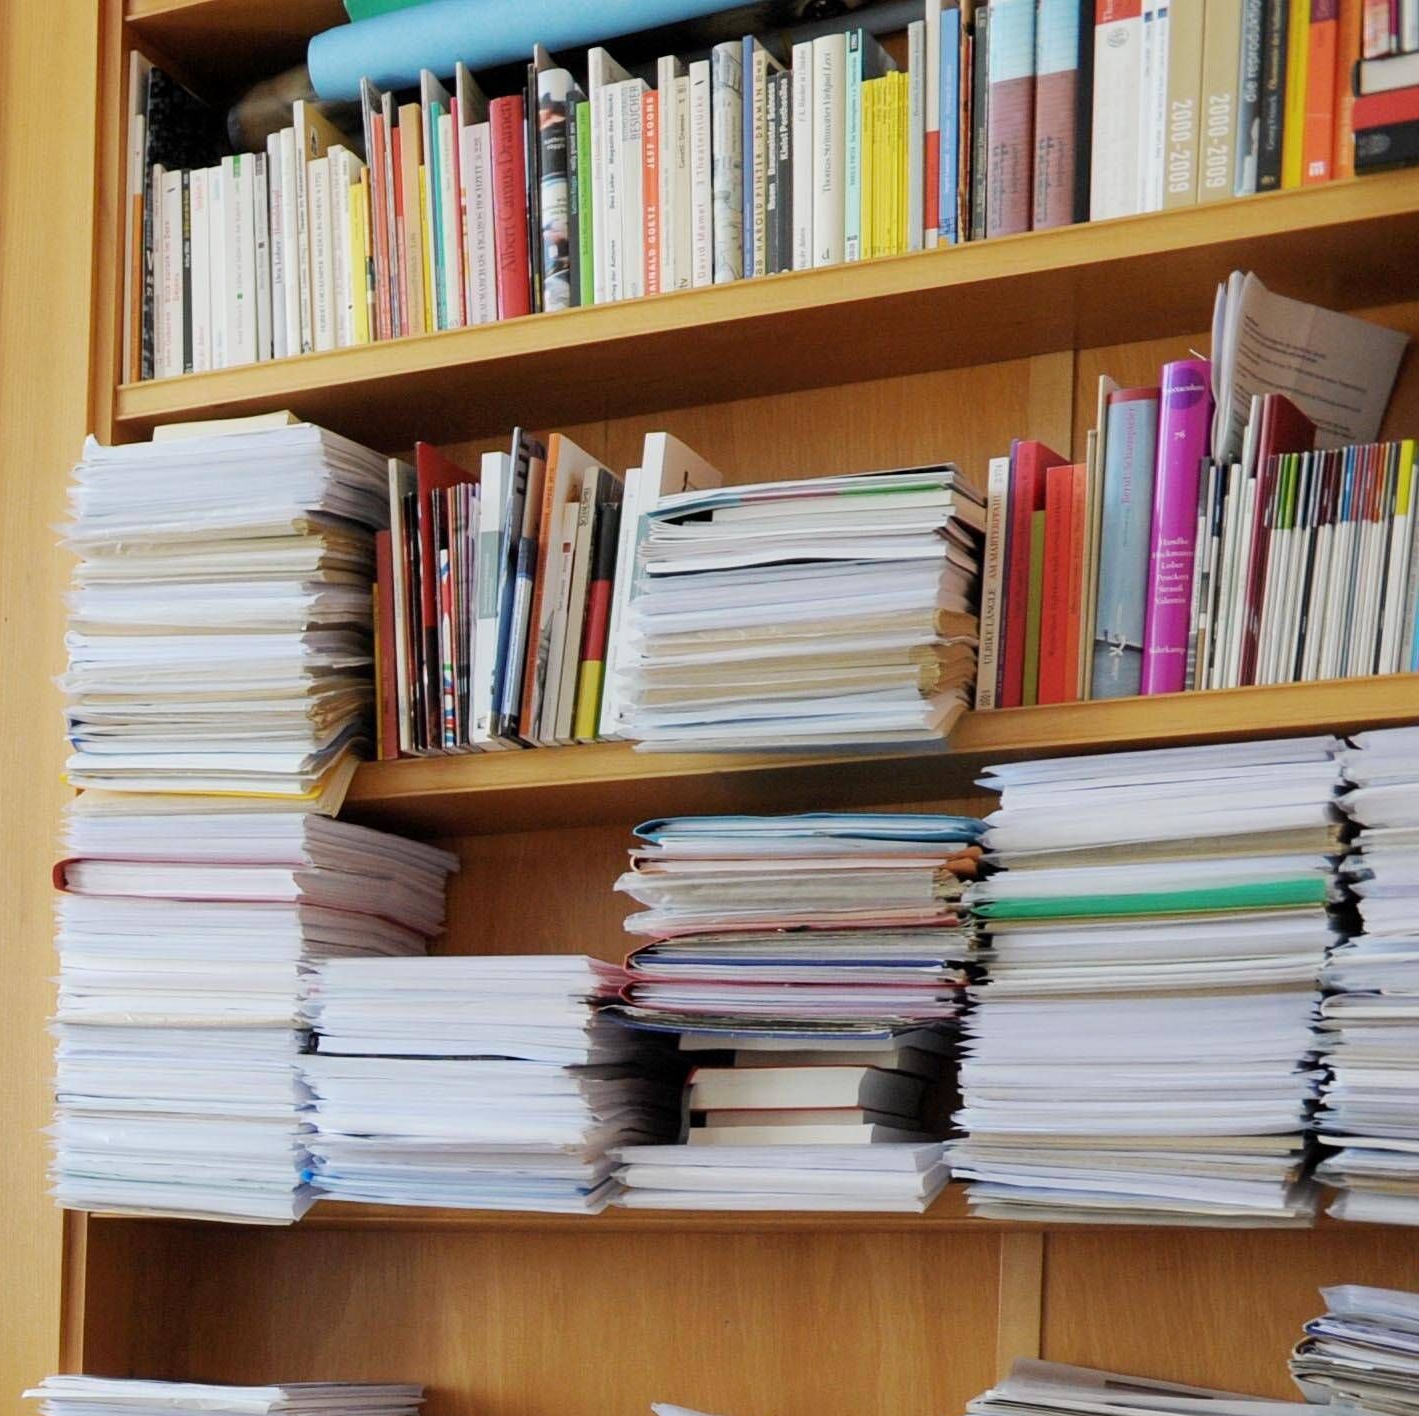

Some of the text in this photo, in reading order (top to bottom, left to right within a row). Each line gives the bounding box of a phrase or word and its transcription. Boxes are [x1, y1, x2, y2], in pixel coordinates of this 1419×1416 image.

[1244, 81, 1258, 102] die
[627, 85, 641, 141] BESUCHER
[645, 96, 655, 137] KOONS
[695, 95, 706, 176] Theaterstücke
[645, 143, 655, 169] JEFF
[753, 152, 763, 198] PINTER
[821, 157, 832, 192] Thomas
[497, 101, 518, 273] Albert Camus Dramen
[645, 205, 657, 243] GOETZ
[696, 203, 707, 242] Mamet
[754, 202, 764, 252] HAROLD
[696, 246, 708, 279] David
[989, 494, 1002, 563] MARTERPFAHL
[988, 564, 998, 579] AM
[983, 629, 995, 665] ULRIKE
